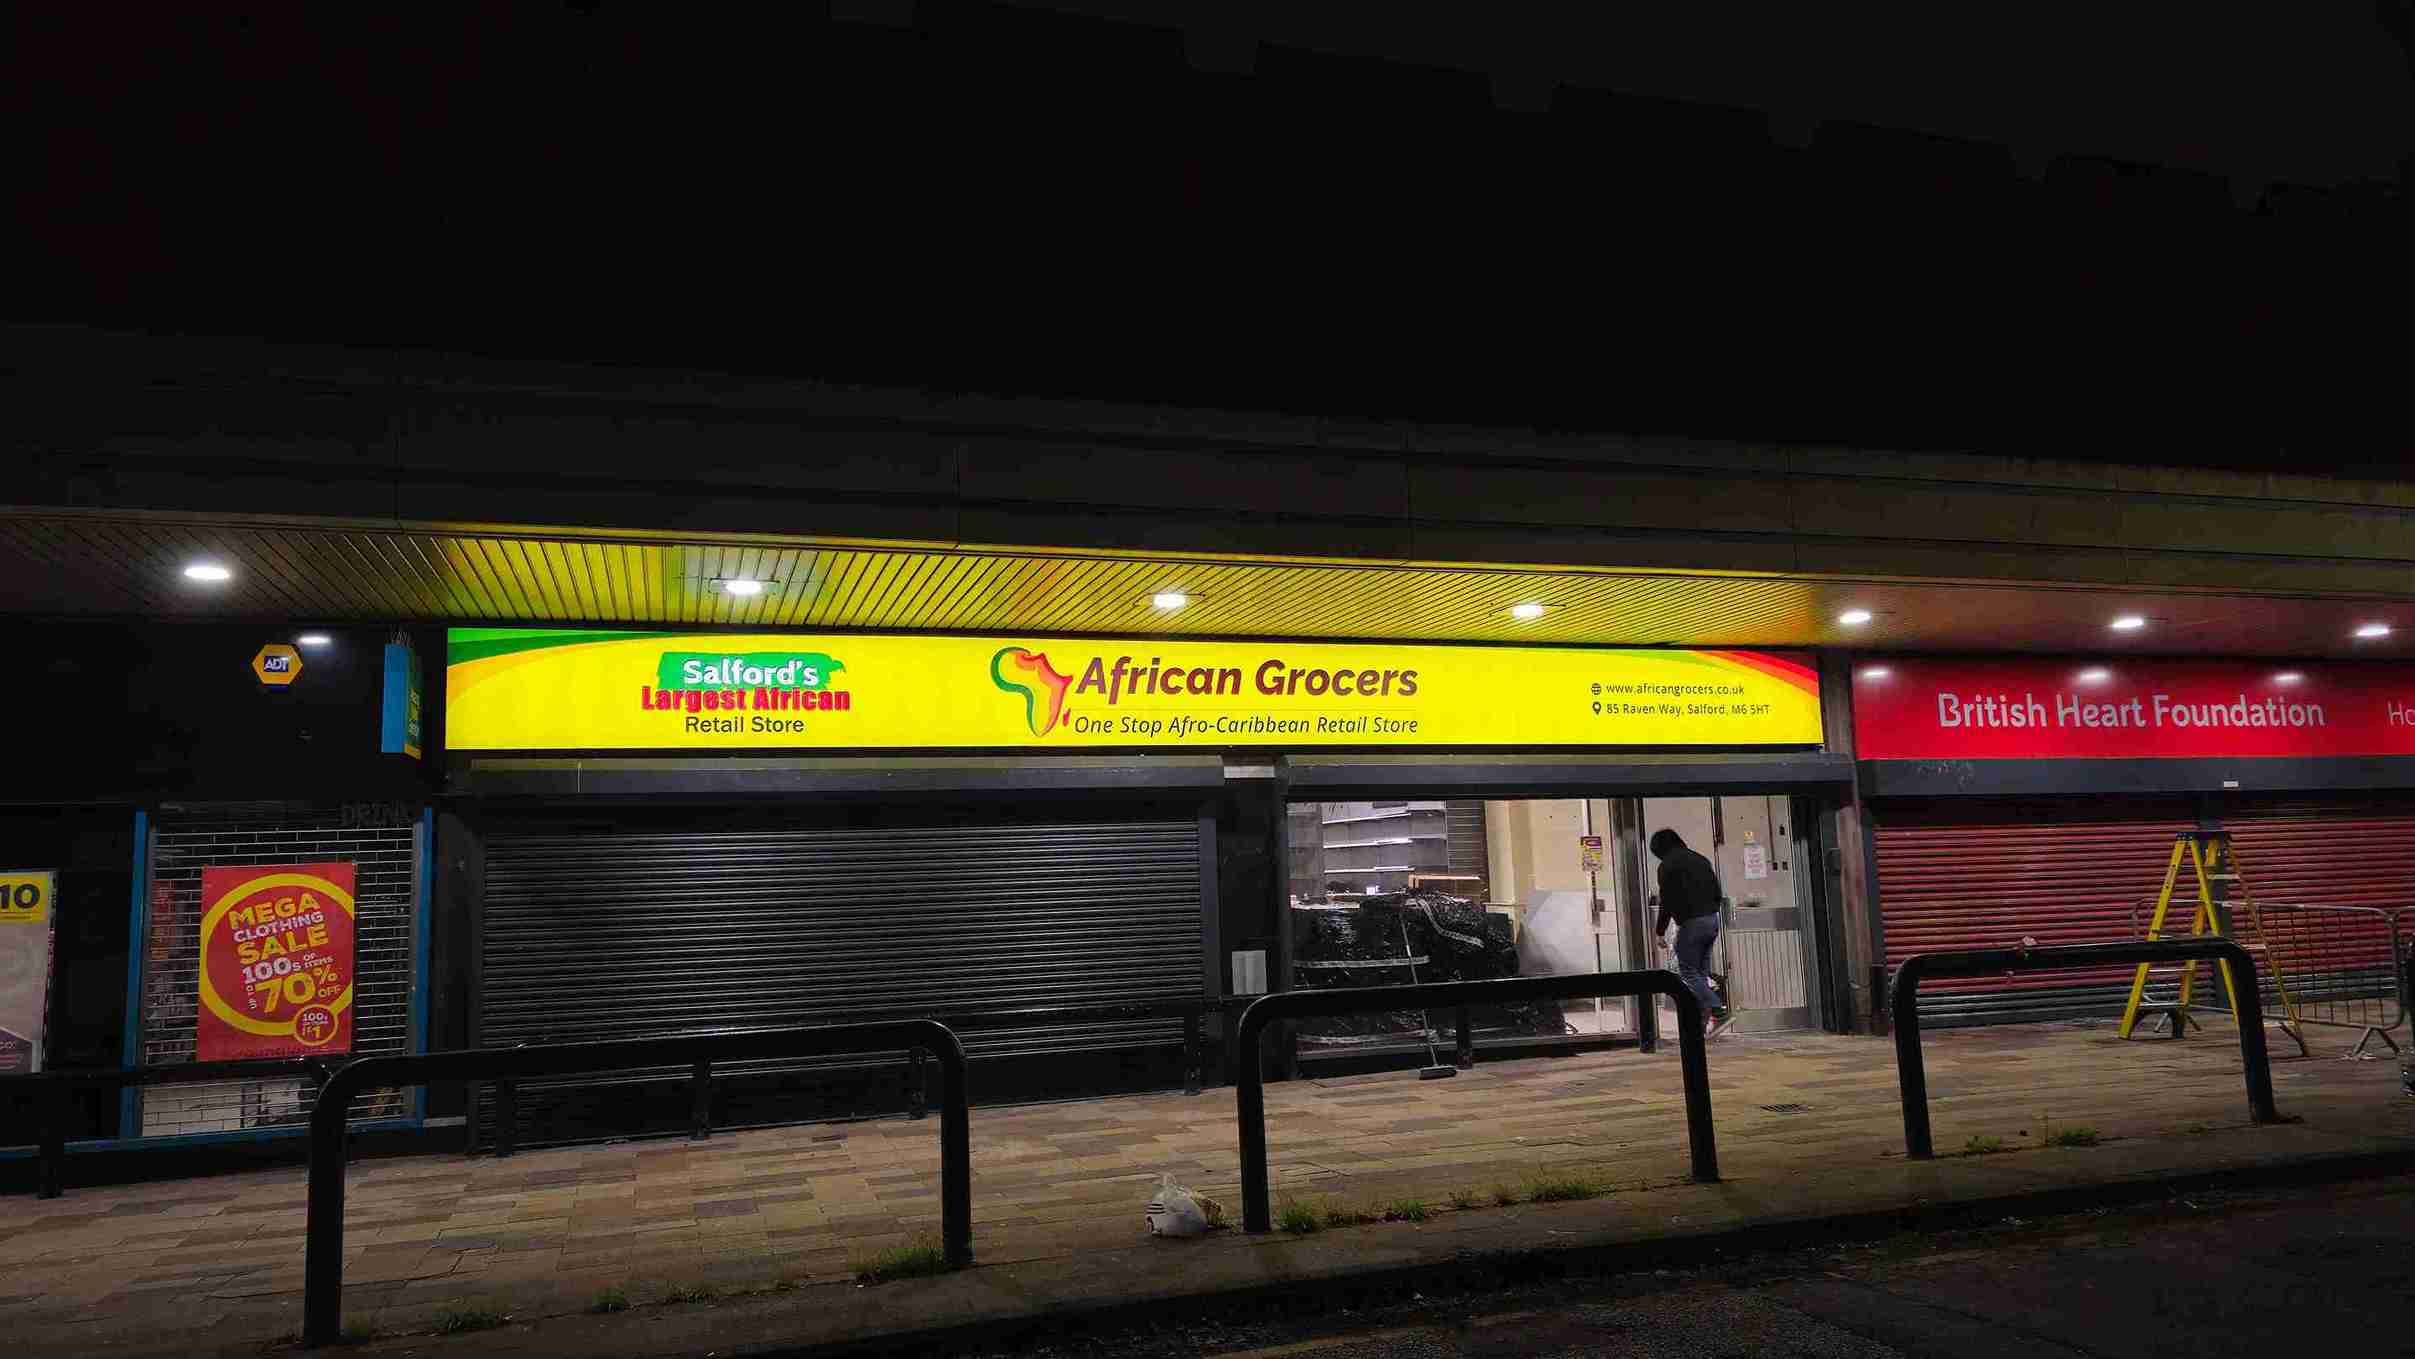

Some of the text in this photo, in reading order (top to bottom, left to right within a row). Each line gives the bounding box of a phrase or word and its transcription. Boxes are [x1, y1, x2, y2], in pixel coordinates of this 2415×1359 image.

[264, 657, 289, 671] ADT
[683, 658, 819, 686] Salford's
[1076, 656, 1418, 705] African Grocers
[1606, 682, 1745, 697] www.africangrocers.co.uk
[641, 685, 850, 713] Largest African
[1606, 703, 1620, 714] 85
[1623, 703, 1656, 714] Raven
[1732, 704, 1747, 714] M6
[1750, 704, 1769, 714] 5HT
[1937, 692, 2326, 729] British Heart Foundation
[685, 716, 805, 733] Retail Store
[1075, 715, 1418, 738] One Stop Afro-Caribbean Retail Store
[229, 893, 320, 929] MEGA
[233, 911, 324, 943] CLOTHING
[237, 924, 330, 966] SALE
